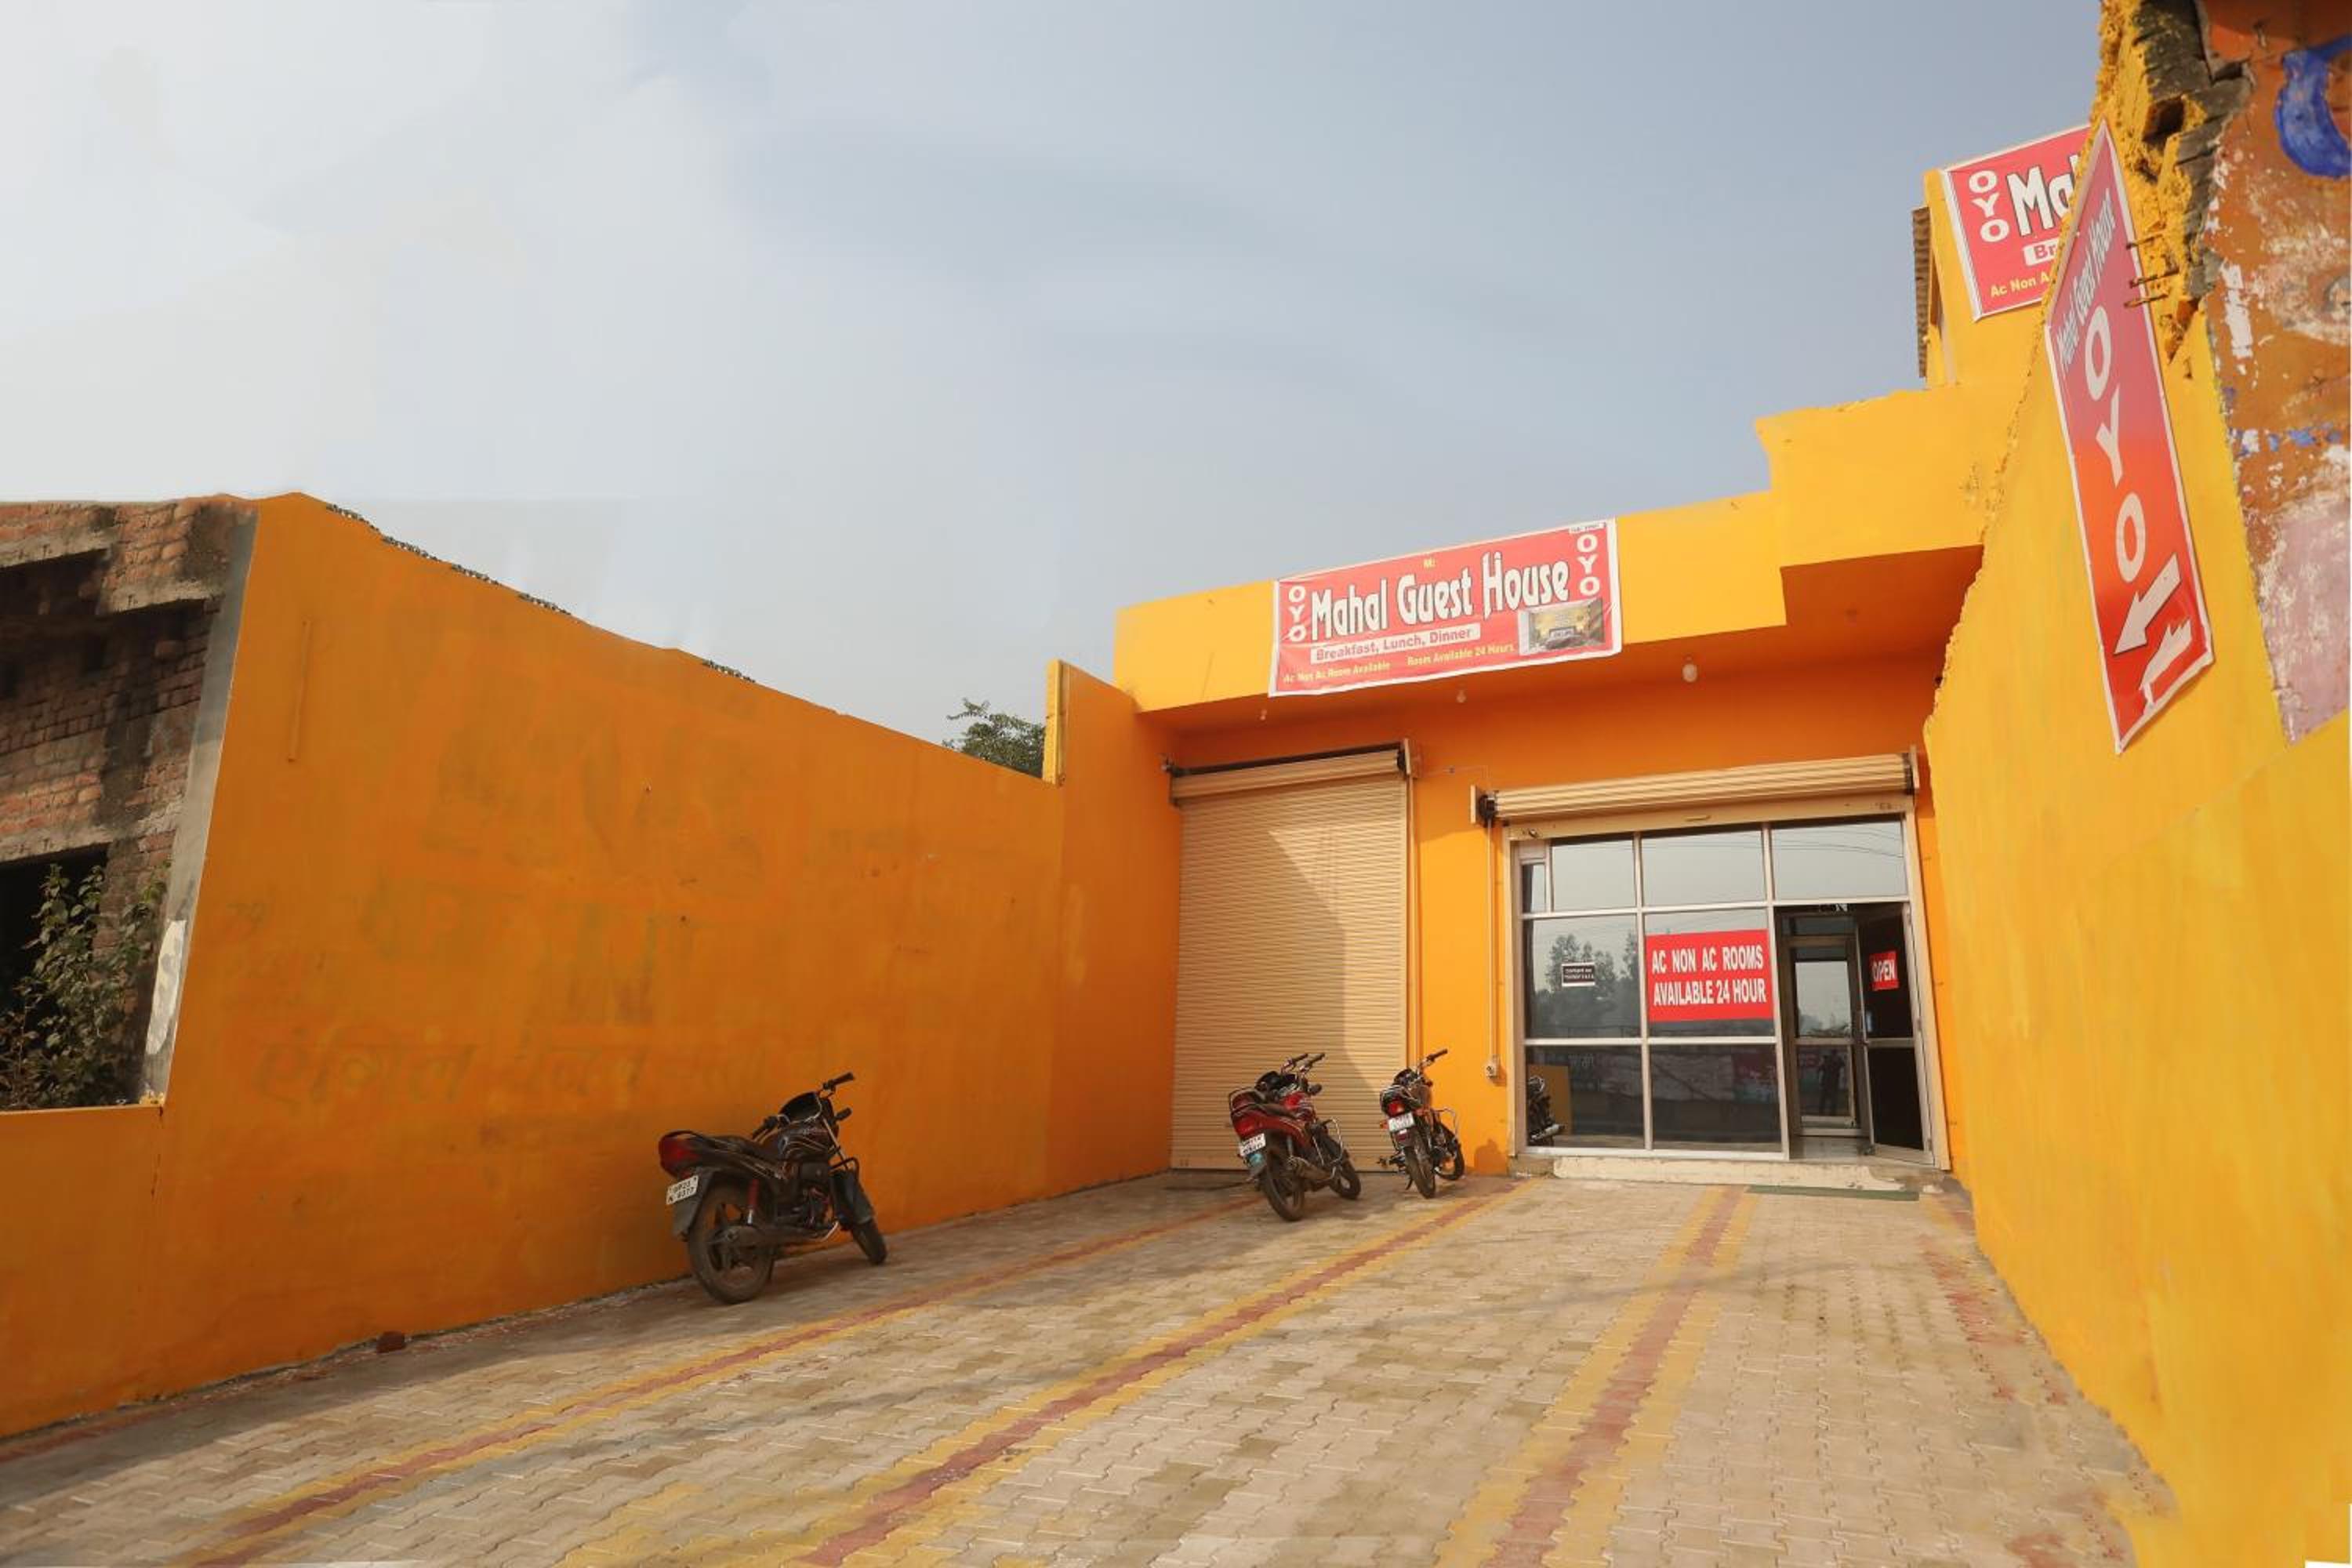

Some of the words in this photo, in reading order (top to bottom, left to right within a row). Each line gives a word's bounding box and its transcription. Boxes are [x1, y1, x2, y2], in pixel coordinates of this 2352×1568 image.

[1969, 162, 2009, 242] OYO
[2007, 155, 2079, 236] Ma
[1991, 284, 2008, 297] Ac
[2010, 276, 2037, 292] Non
[2085, 306, 2146, 583] OYO
[1576, 534, 1600, 596] OYO
[1311, 578, 1388, 641] Mahal
[1397, 565, 1473, 626] Guest
[1481, 550, 1570, 620] House
[1288, 586, 1307, 642] OYO
[1316, 643, 1380, 661] Breakfast,
[1429, 628, 1471, 644] Dinner
[1433, 648, 1473, 663] Available
[1353, 660, 1391, 675] Available
[1652, 949, 1667, 974] AC
[1671, 947, 1697, 973] NON
[1701, 946, 1718, 971] AC
[1722, 944, 1763, 971] ROOMS
[1871, 959, 1896, 982] OPEN
[1653, 979, 1714, 1006] AVAILABLE
[1715, 979, 1730, 1004] 24
[1732, 977, 1767, 1004] HOUR
